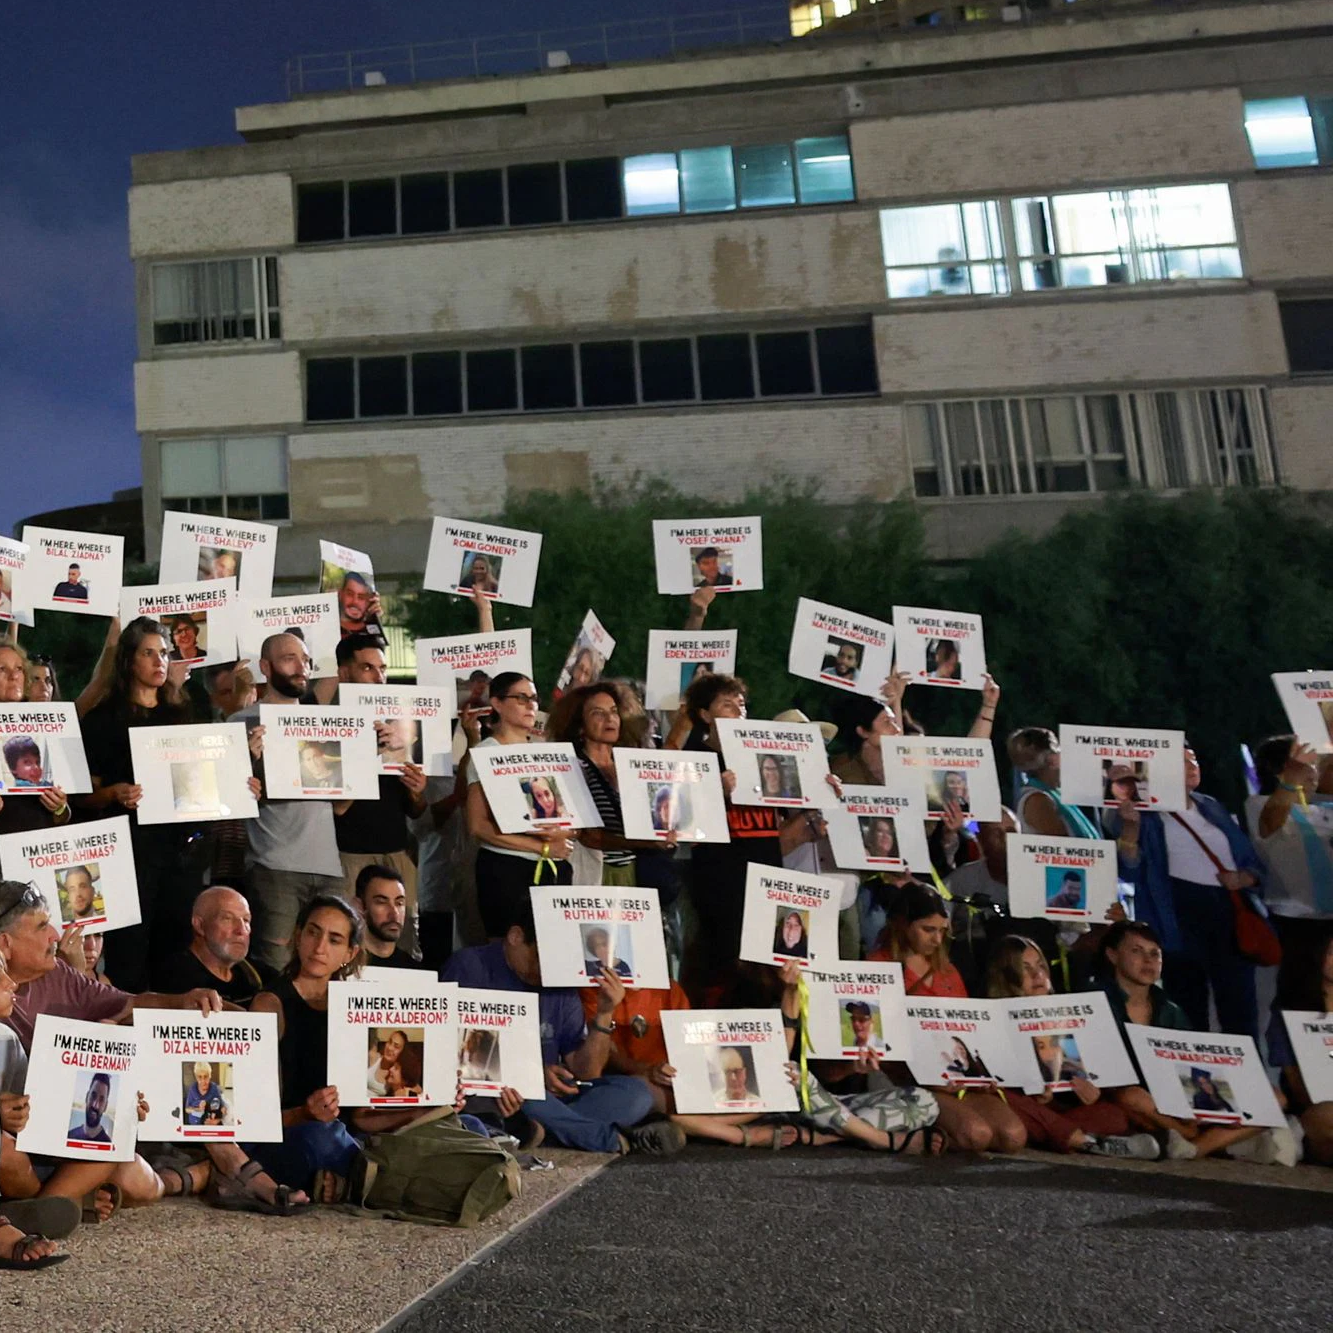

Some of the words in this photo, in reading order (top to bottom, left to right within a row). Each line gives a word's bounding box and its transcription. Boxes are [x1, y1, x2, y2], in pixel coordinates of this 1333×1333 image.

[138, 597, 154, 606] I'M
[185, 591, 218, 603] WHERE
[219, 590, 226, 598] IS
[20, 714, 57, 723] WHERE
[58, 714, 66, 722] IS
[278, 717, 292, 727] I'M
[321, 717, 355, 727] WHERE
[357, 718, 364, 727] IS
[6, 724, 63, 733] BRODUTCH?
[348, 997, 365, 1010] I'M
[399, 998, 440, 1010] WHERE
[440, 998, 447, 1010] IS
[347, 1011, 384, 1024] SAHAR
[386, 1011, 448, 1024] KALDERON?
[153, 1025, 170, 1038] I'M
[205, 1027, 249, 1041] WHERE
[251, 1029, 261, 1041] IS
[55, 1034, 74, 1050] I'M
[104, 1040, 131, 1056] WHERE
[163, 1042, 191, 1054] DIZA
[193, 1042, 251, 1056] HEYMAN?
[61, 1051, 89, 1066] GALI
[90, 1056, 131, 1072] BERMAN?
